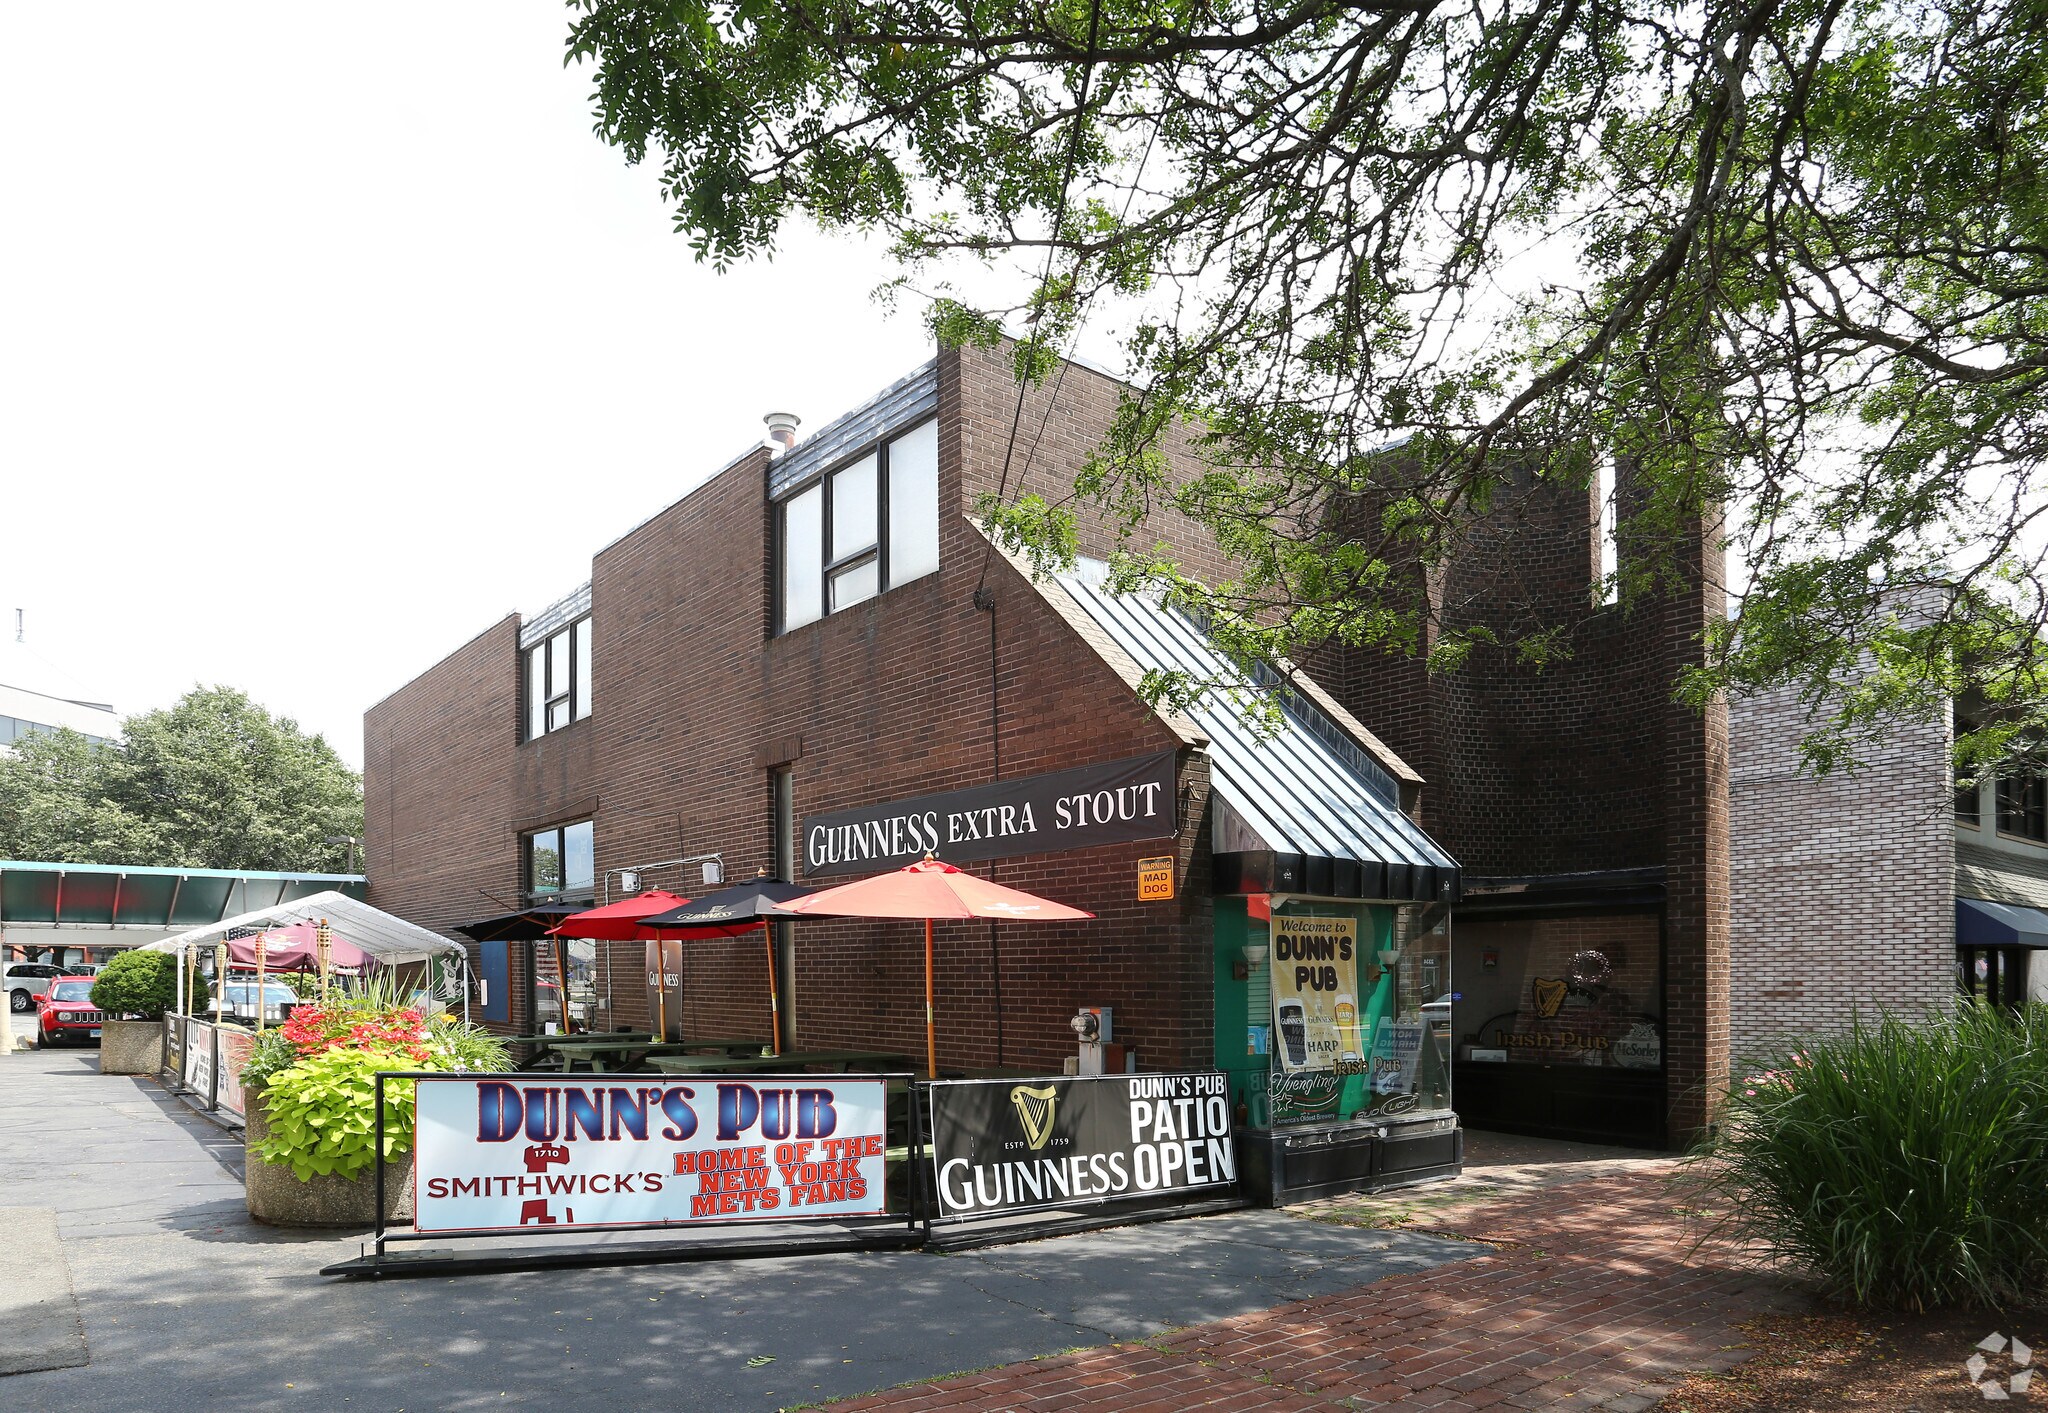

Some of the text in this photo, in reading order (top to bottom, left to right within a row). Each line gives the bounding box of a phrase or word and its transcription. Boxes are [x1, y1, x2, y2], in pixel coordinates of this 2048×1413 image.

[808, 781, 1161, 868] GUINNESS EXTRA STOUT
[1140, 861, 1171, 871] WARNING
[1143, 872, 1168, 882] MAD
[1144, 884, 1168, 893] DOG
[1280, 919, 1347, 932] Welcome to
[1276, 934, 1352, 961] DUNN'S
[648, 971, 679, 987] GUINESS
[1295, 965, 1338, 992] PUB
[1308, 1040, 1339, 1052] HARP
[1129, 1075, 1225, 1100] DUNN'S PUB
[1267, 1072, 1339, 1097] Yuengling
[476, 1081, 837, 1143] DUNN'S PUB
[1130, 1096, 1228, 1144] PATIO
[1299, 1114, 1316, 1122] Oldest
[534, 1149, 560, 1158] 1710
[1050, 1137, 1069, 1146] 1759
[673, 1134, 883, 1176] HOME OF THE
[1133, 1137, 1234, 1191] OPEN
[426, 1171, 663, 1198] SMITHWICK'S
[698, 1157, 861, 1195] NEW YORK
[939, 1151, 1129, 1210] GUINNESS
[689, 1178, 868, 1218] METS FANS
